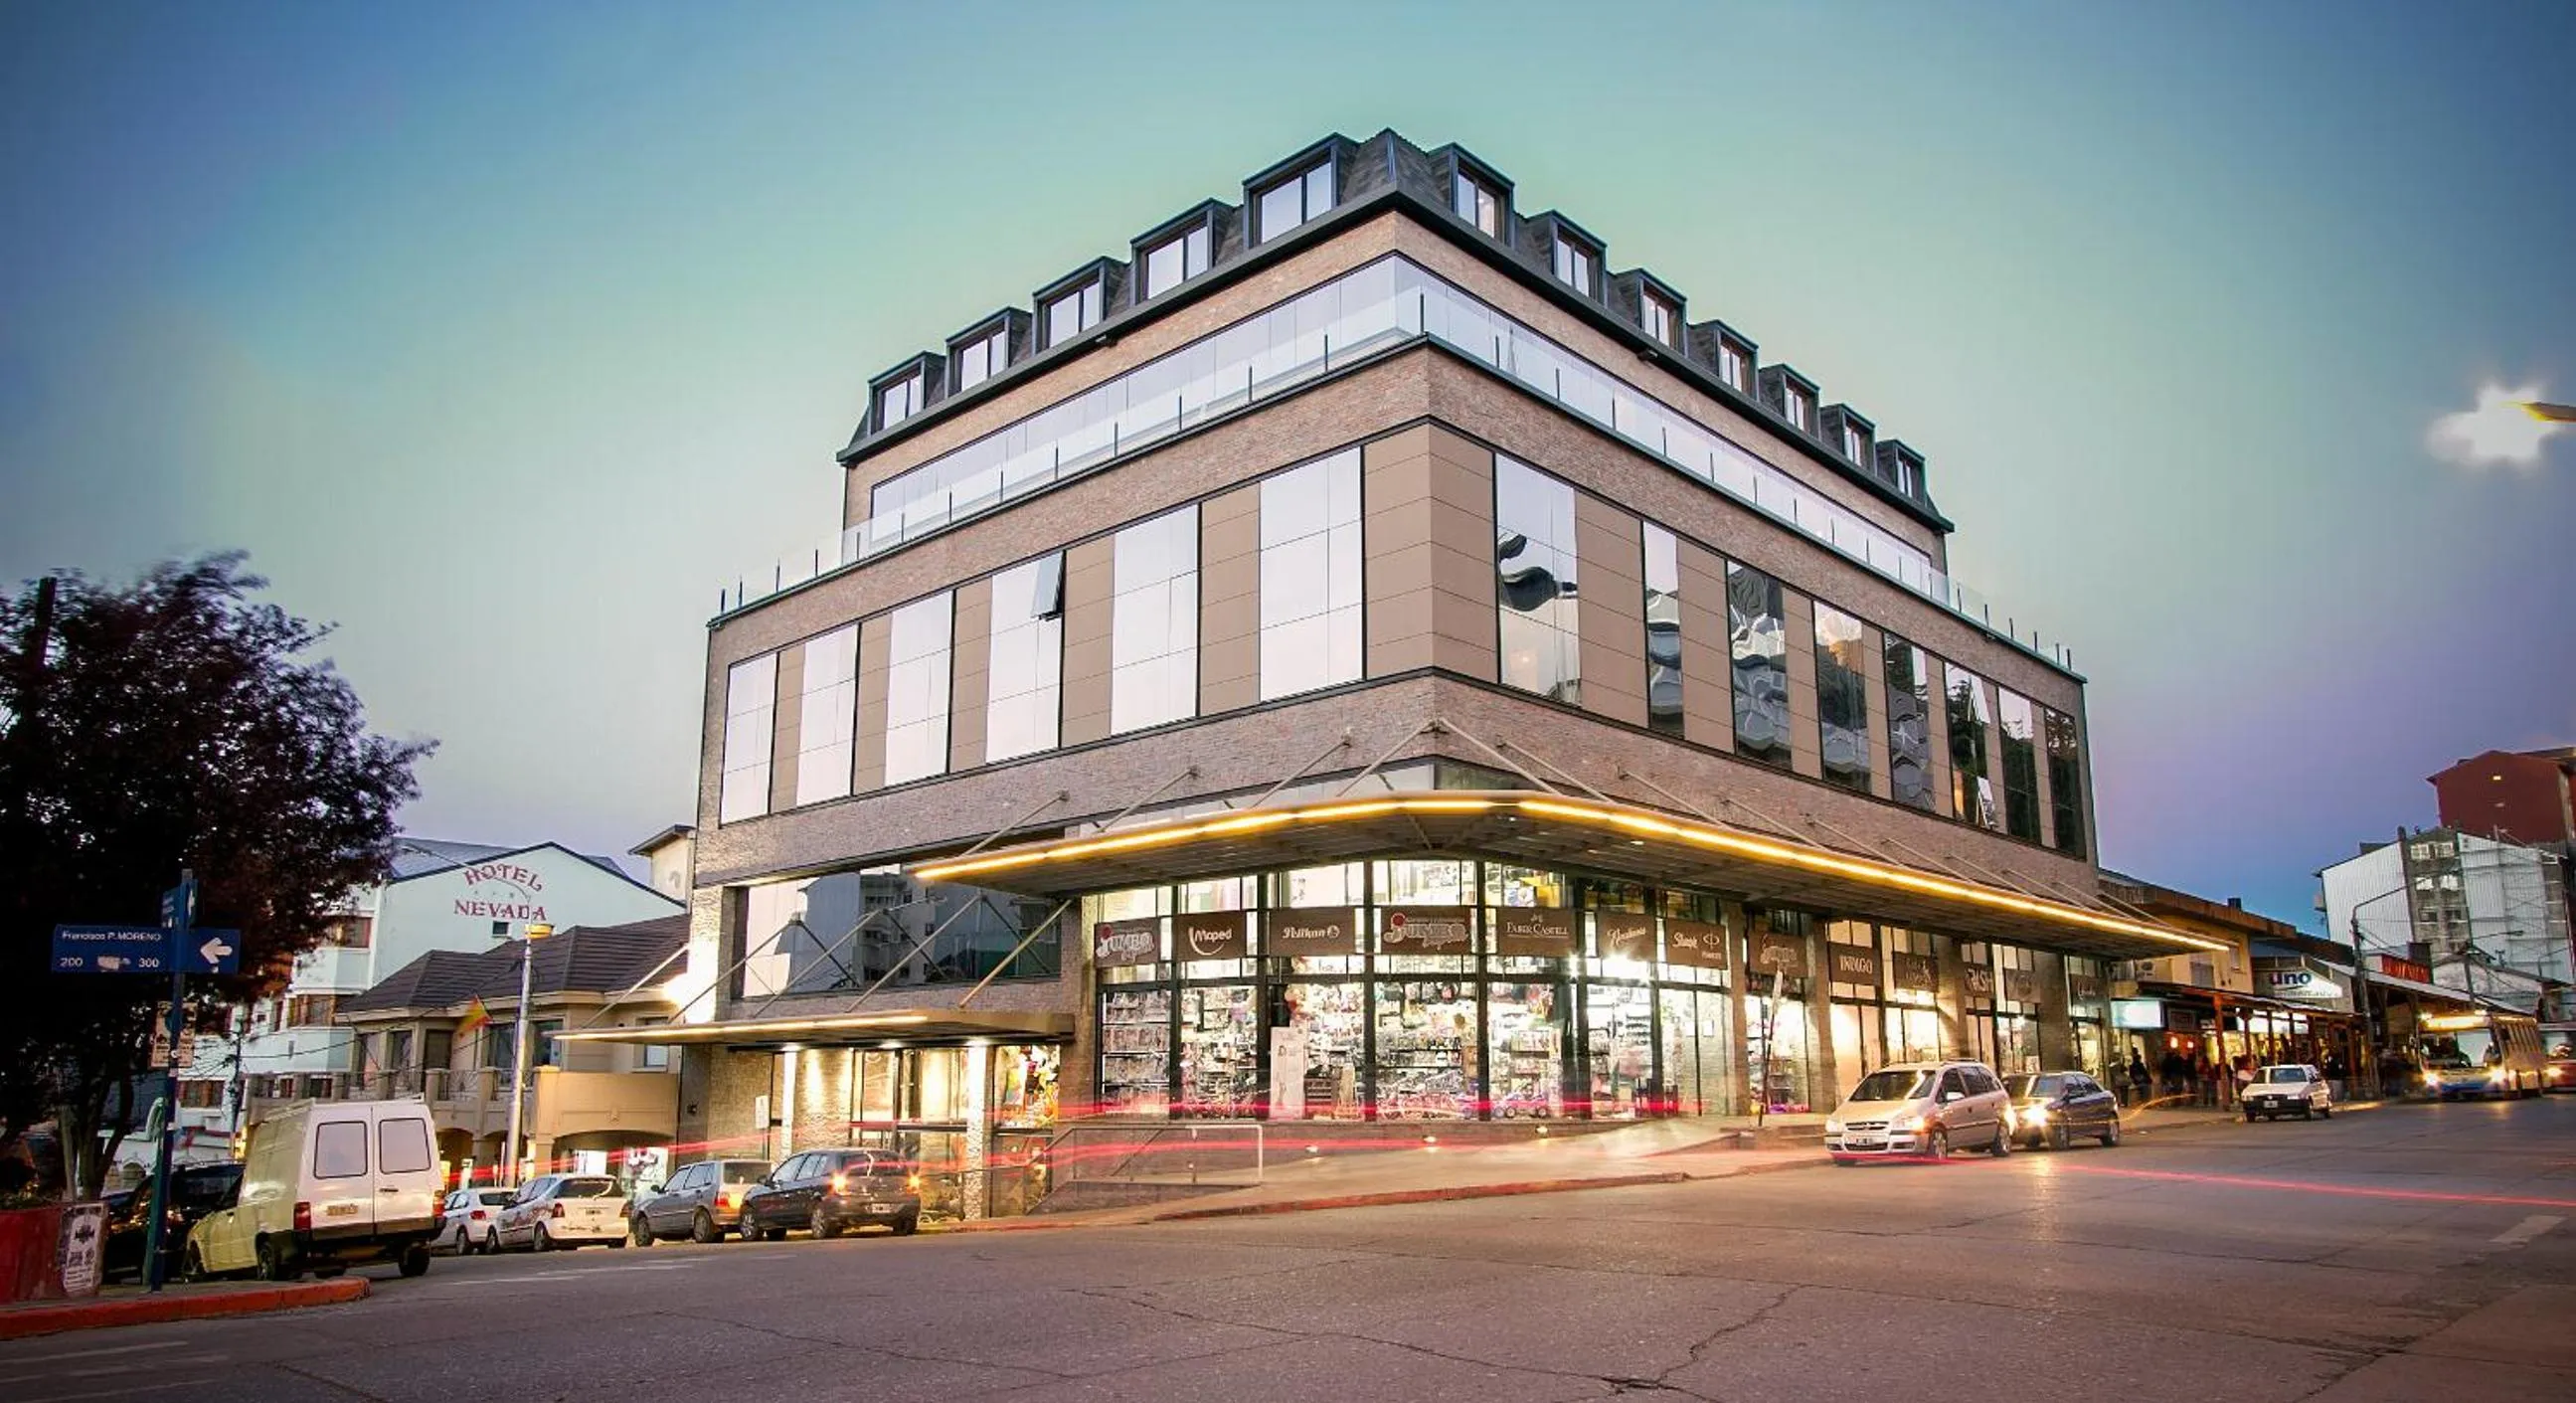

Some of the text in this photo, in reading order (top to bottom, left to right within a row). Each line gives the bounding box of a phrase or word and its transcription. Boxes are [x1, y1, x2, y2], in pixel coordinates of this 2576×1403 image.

[463, 863, 542, 891] HOTEL
[453, 899, 547, 921] NEVADA
[1194, 929, 1232, 943] Maped
[1282, 926, 1325, 941] Pelikan
[60, 958, 83, 967] 200
[138, 957, 160, 968] 300
[2269, 970, 2313, 985] uno
